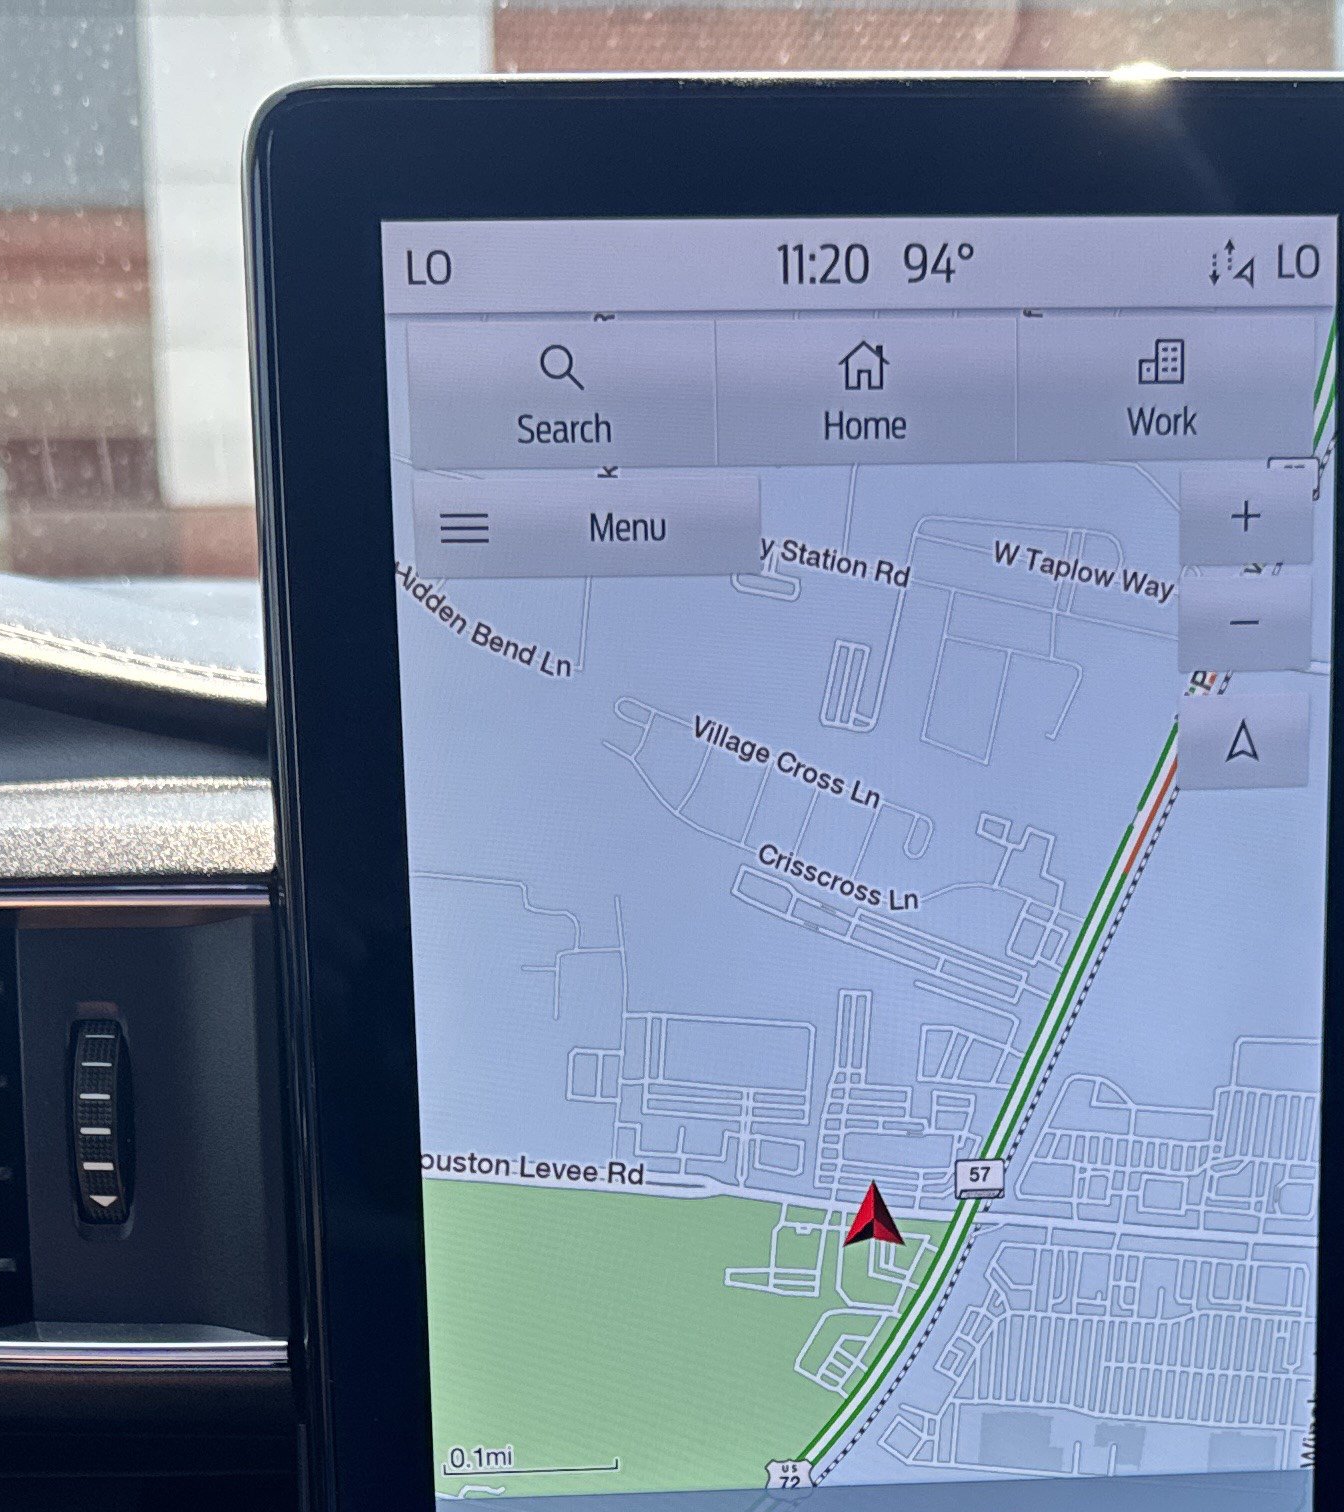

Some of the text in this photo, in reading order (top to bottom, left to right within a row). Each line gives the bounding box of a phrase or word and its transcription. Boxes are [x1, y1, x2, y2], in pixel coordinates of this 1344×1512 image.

[406, 249, 452, 286] LO
[777, 242, 974, 285] 11:20 94°
[1277, 244, 1320, 279] LO
[517, 412, 612, 445] Search
[824, 410, 907, 441] Home
[1126, 405, 1197, 436] Work
[590, 512, 666, 543] Menu
[781, 540, 866, 577] Station
[875, 561, 911, 588] Rd
[994, 540, 1176, 603] W Taplow Way
[471, 622, 536, 666] Bend
[541, 651, 571, 677] Ln
[694, 715, 880, 809] Village Cross Ln
[758, 844, 919, 910] Crisscross Ln
[520, 1156, 598, 1182] Levee
[608, 1161, 644, 1186] Rd
[969, 1166, 991, 1182] 57
[449, 1447, 513, 1470] 0.1mi
